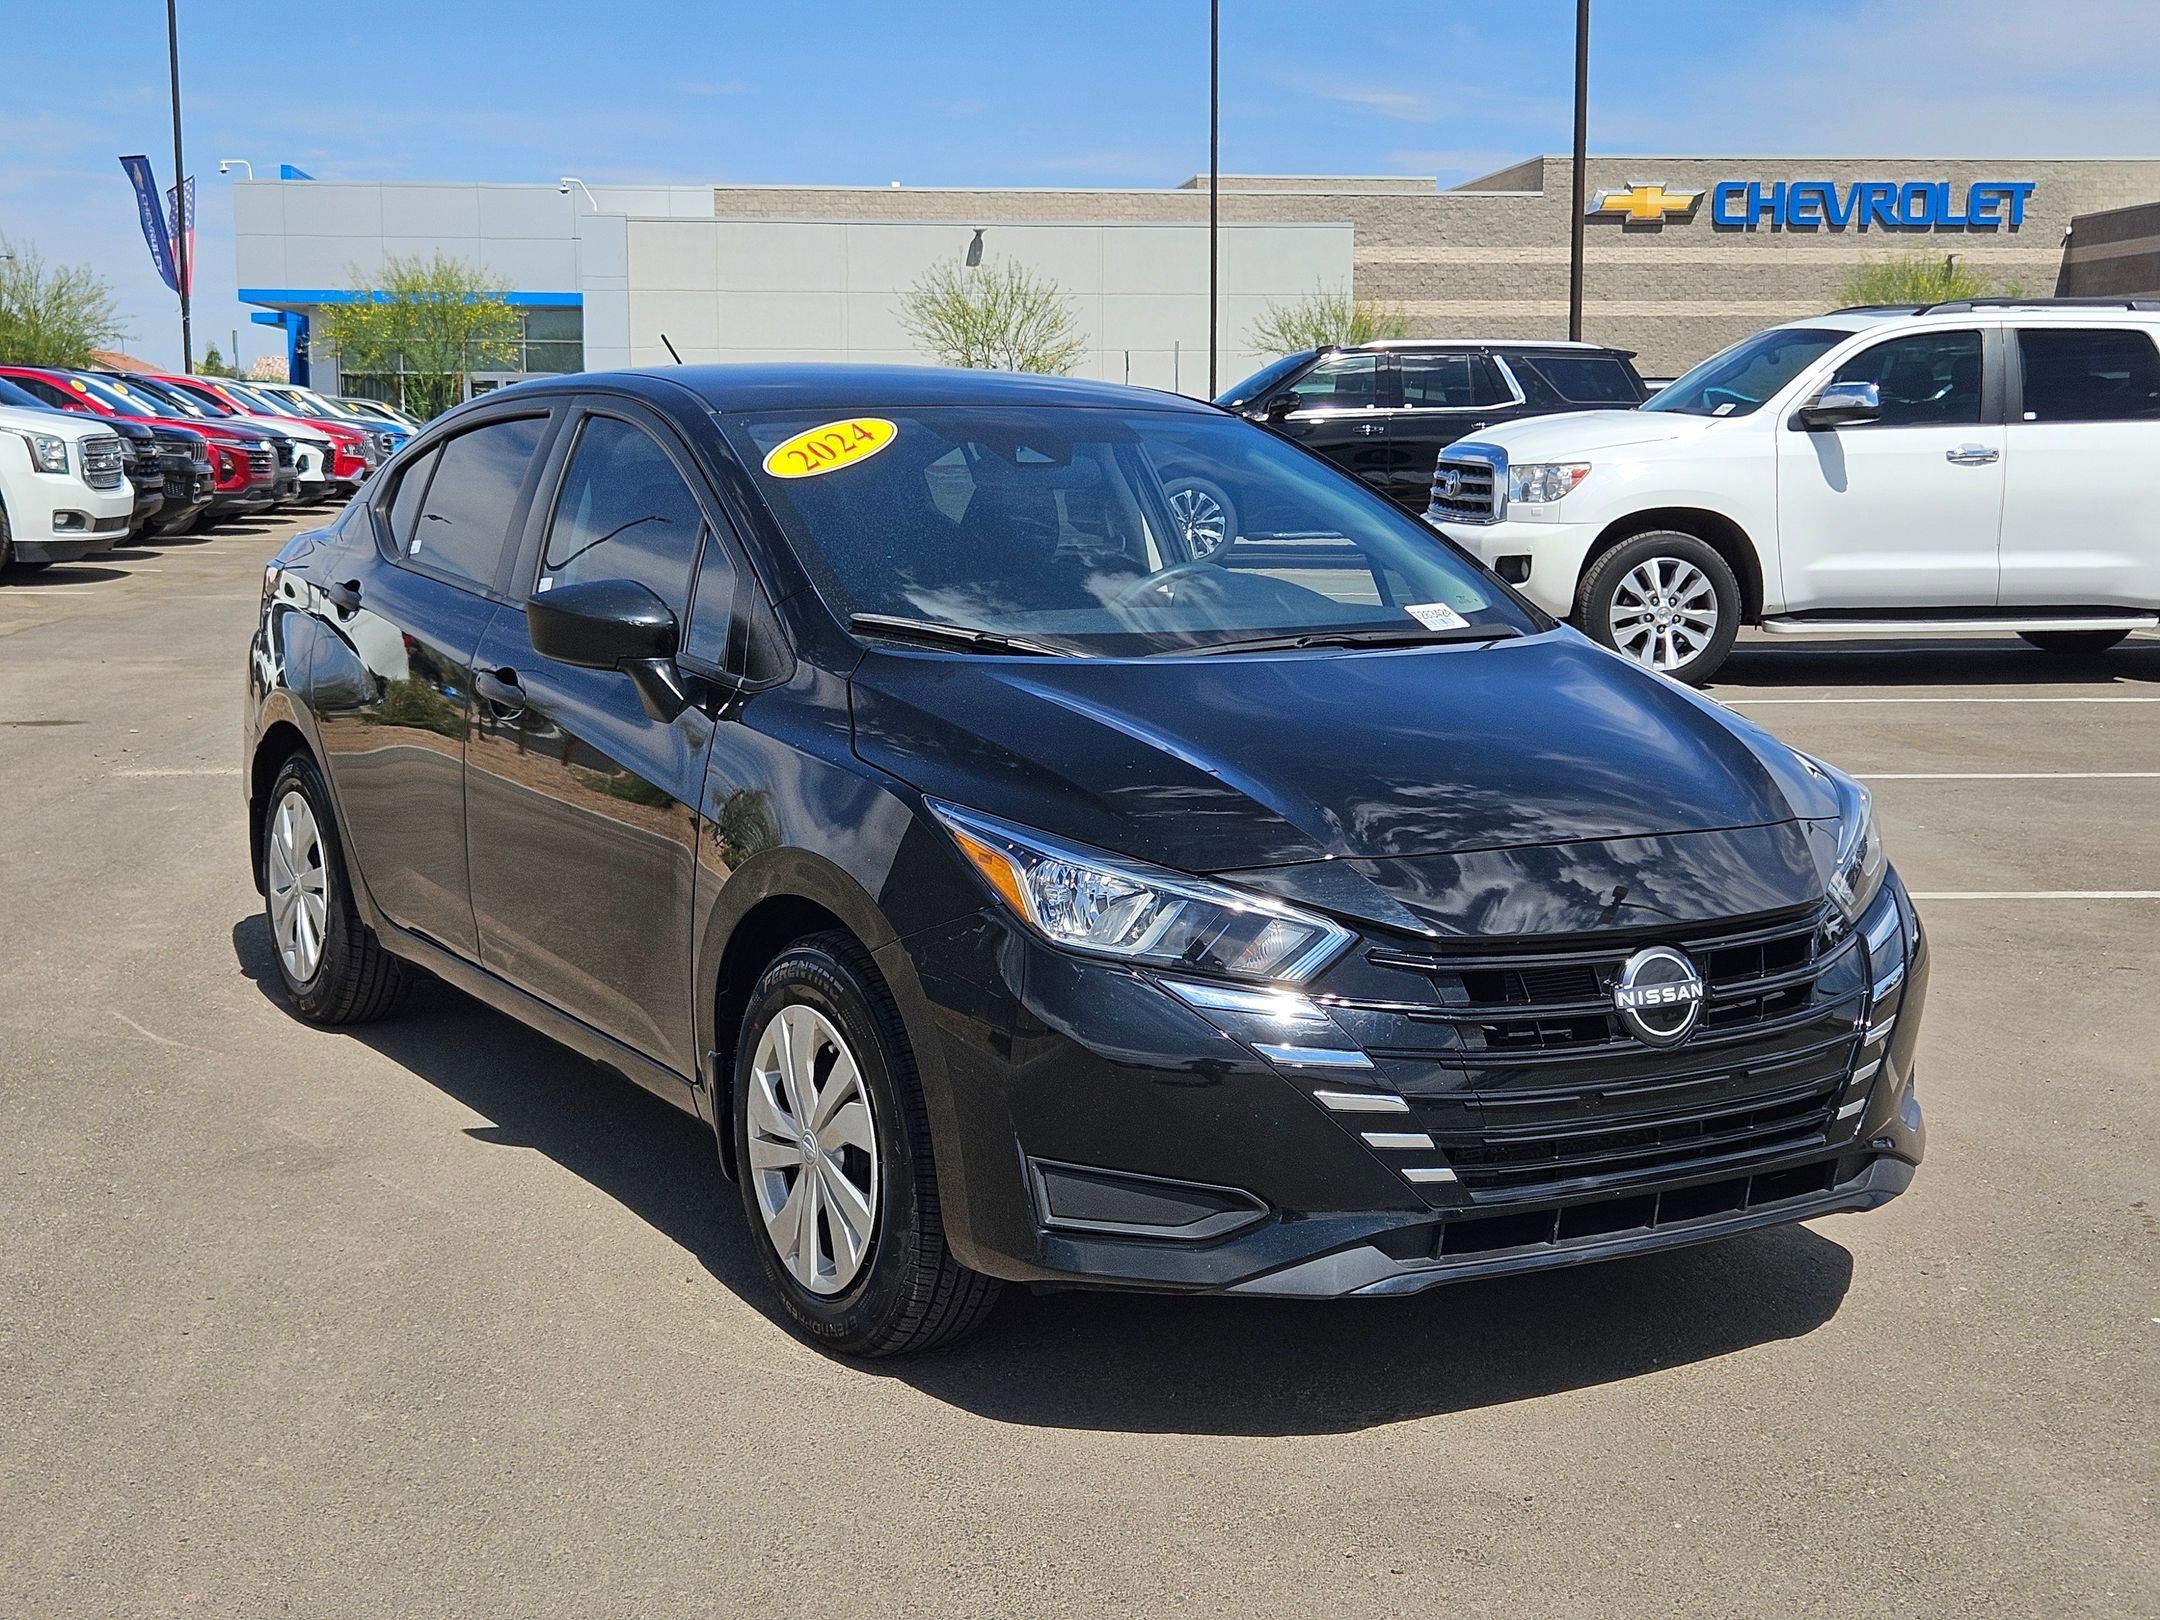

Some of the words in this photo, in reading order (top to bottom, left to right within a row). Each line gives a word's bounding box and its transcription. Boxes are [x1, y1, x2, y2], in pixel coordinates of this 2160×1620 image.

[1712, 180, 2037, 227] CHEVROLET
[786, 422, 876, 471] 2024
[1616, 982, 1704, 1007] NISSAN
